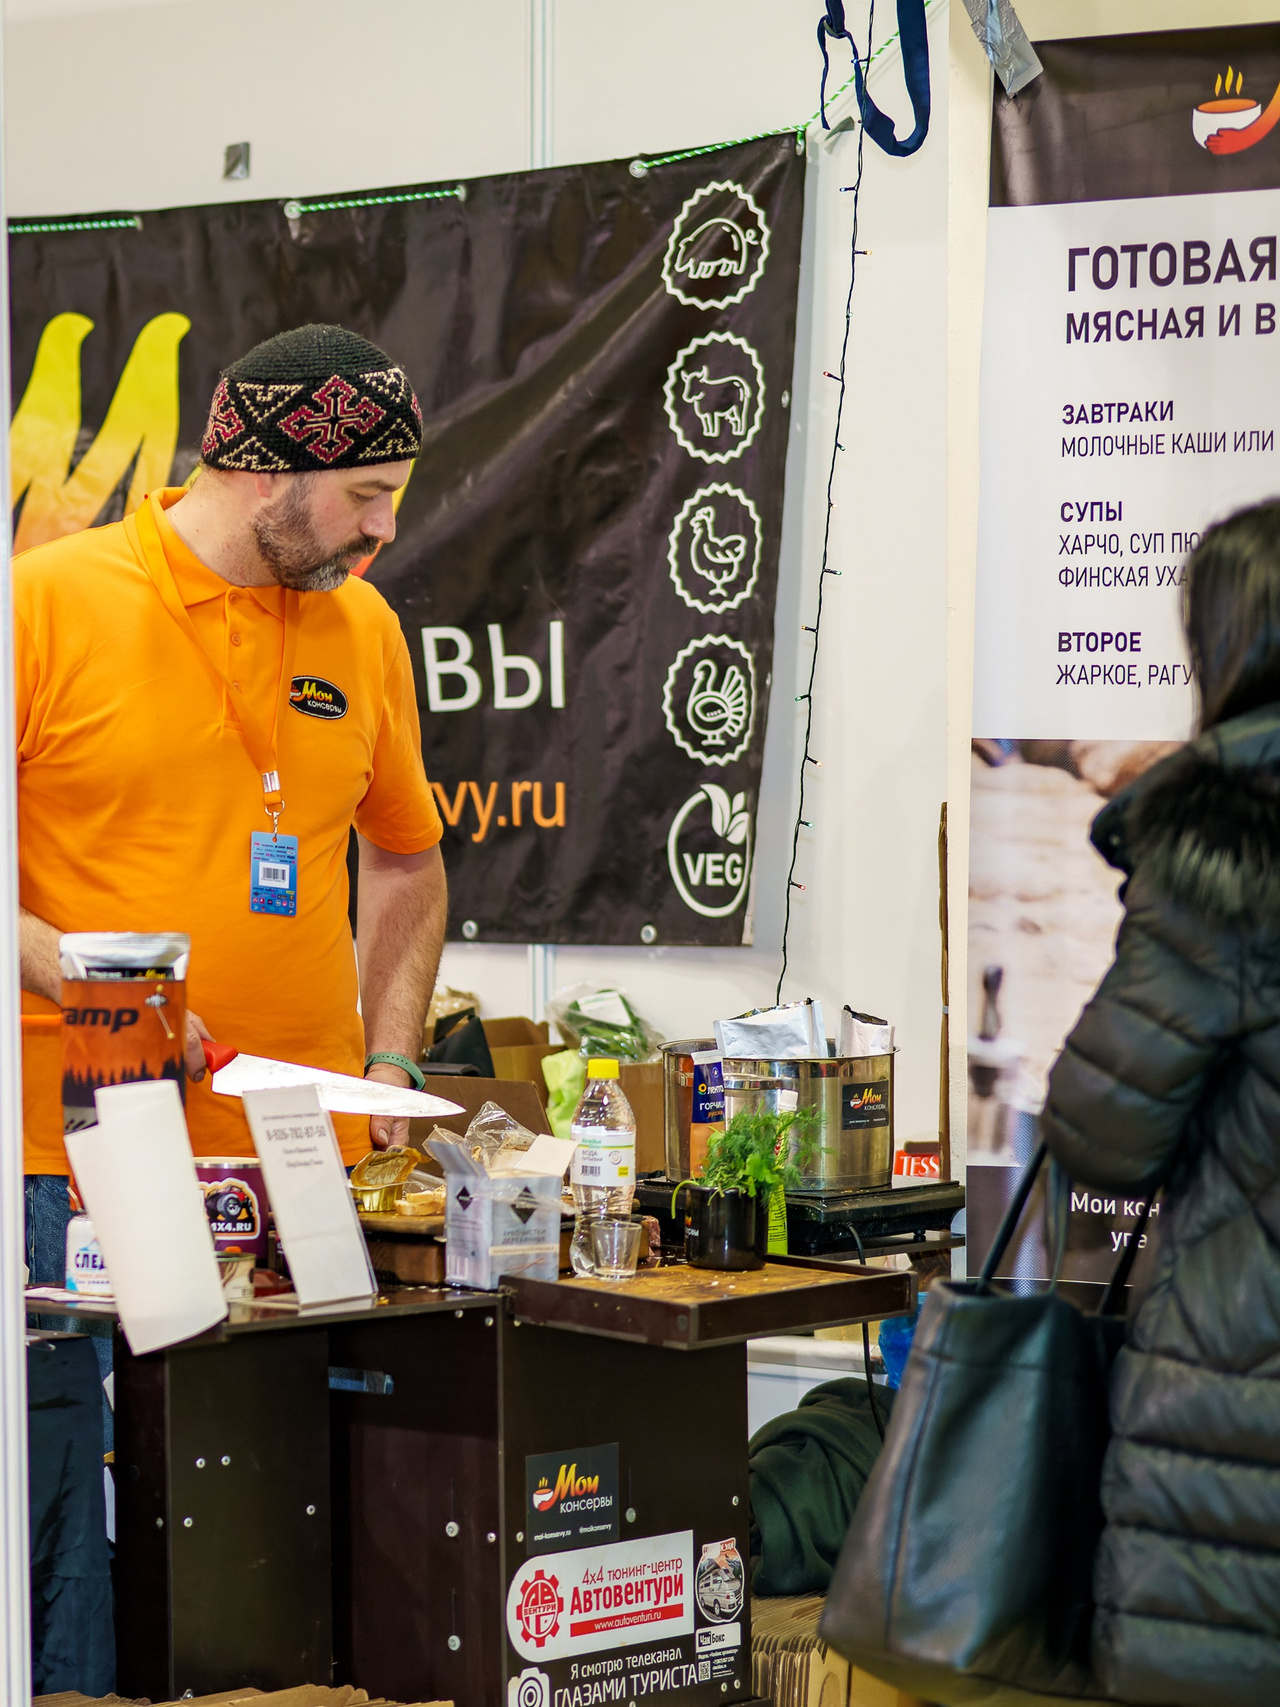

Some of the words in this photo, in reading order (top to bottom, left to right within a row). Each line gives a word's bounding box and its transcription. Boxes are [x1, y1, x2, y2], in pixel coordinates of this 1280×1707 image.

[1067, 235, 1277, 292] ГОТОВАЯ
[1065, 306, 1205, 345] МЯСНАЯ
[1219, 304, 1241, 338] И
[1255, 302, 1276, 335] В
[1061, 400, 1174, 425] ЗАВТРАКИ
[1061, 433, 1166, 458] МОЛОЧНЫЕ
[1171, 431, 1226, 454] КАШИ
[1233, 430, 1274, 452] ИЛИ
[1060, 501, 1123, 523] СУПЫ
[1058, 533, 1124, 557] ХАРЧО,
[1129, 533, 1165, 554] СУП
[1171, 532, 1203, 553] ПЮ
[1058, 565, 1149, 588] ФИНСКАЯ
[1057, 631, 1142, 653] ВТОРОЕ
[1055, 664, 1142, 688] ЖАРКОЕ,
[682, 852, 743, 887] VEG
[899, 1155, 940, 1177] TESS
[1071, 1191, 1116, 1215] Мои
[557, 1463, 599, 1500] Мои
[560, 1496, 613, 1514] консервы
[582, 1565, 604, 1585] 4x4
[607, 1557, 683, 1581] тюнинг-центр
[570, 1573, 683, 1616] Автовентури
[524, 1603, 556, 1616] ВЕНТУРИ
[594, 1610, 662, 1630] www.autoventuri.ru
[571, 1664, 579, 1680] Я
[581, 1657, 623, 1678] смотрю
[627, 1647, 682, 1669] телеканал
[554, 1677, 627, 1707] ГЛАЗАМИ
[630, 1664, 698, 1697] ТУРИСТА
